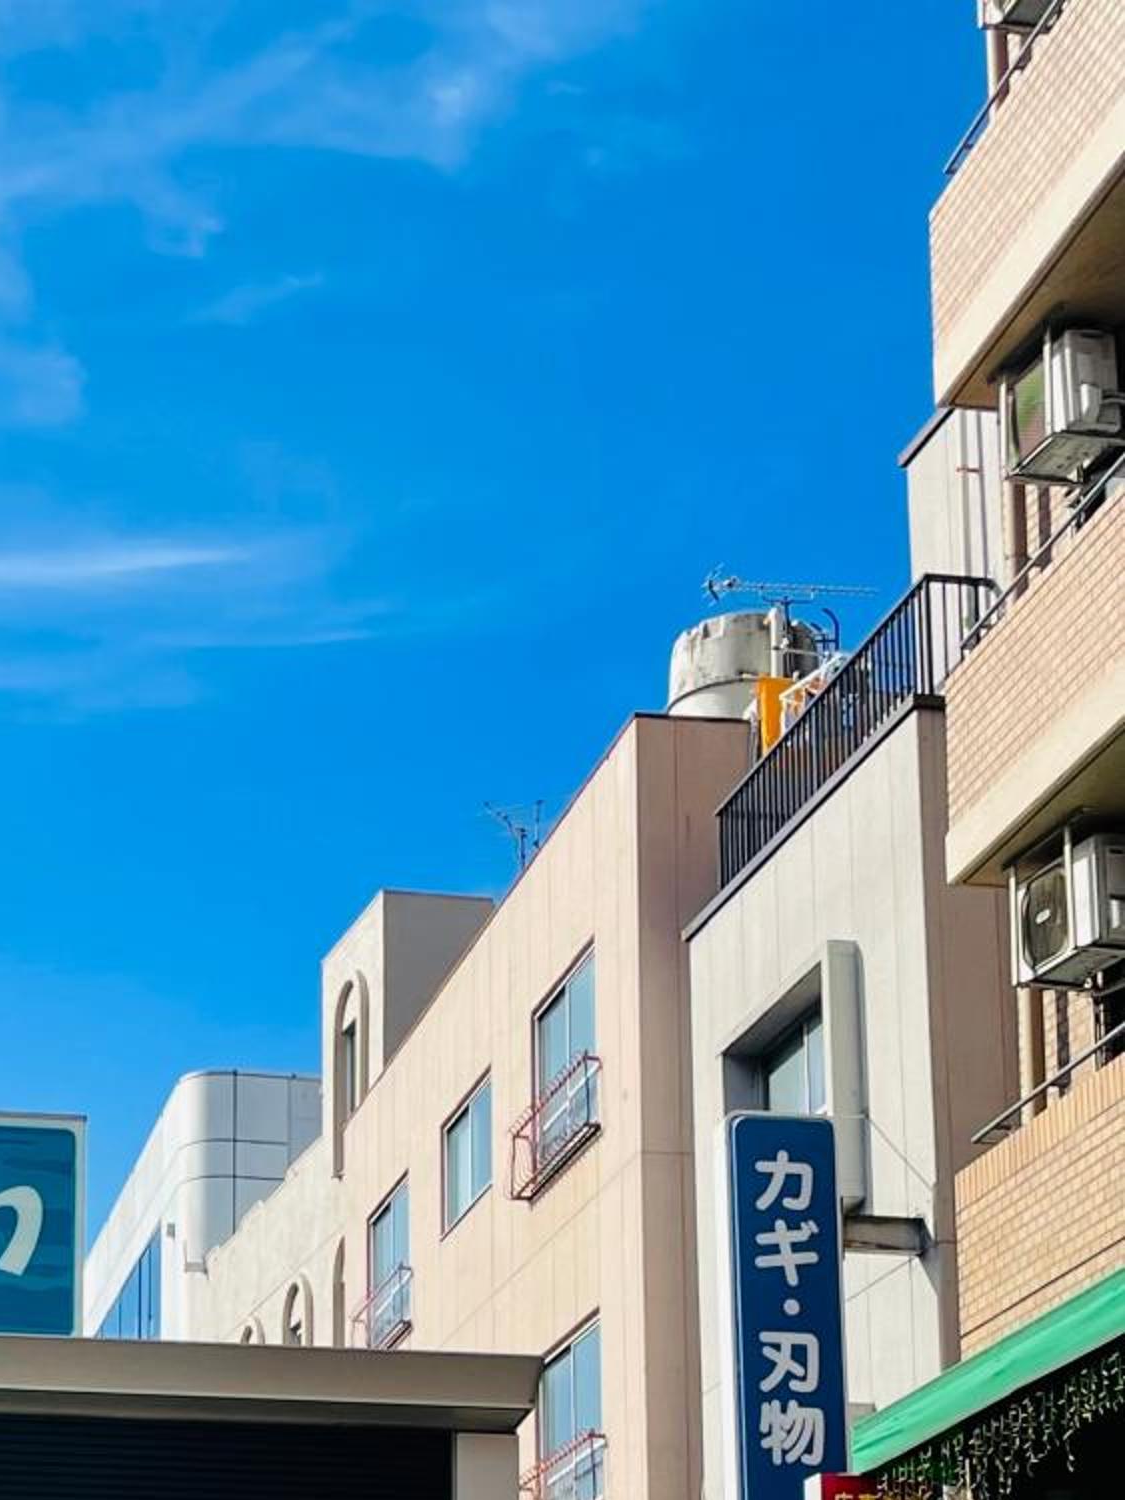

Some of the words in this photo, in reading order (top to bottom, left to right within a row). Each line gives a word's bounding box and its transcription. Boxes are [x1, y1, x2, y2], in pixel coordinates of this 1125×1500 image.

[754, 1149, 825, 1467] カギ・刃物
